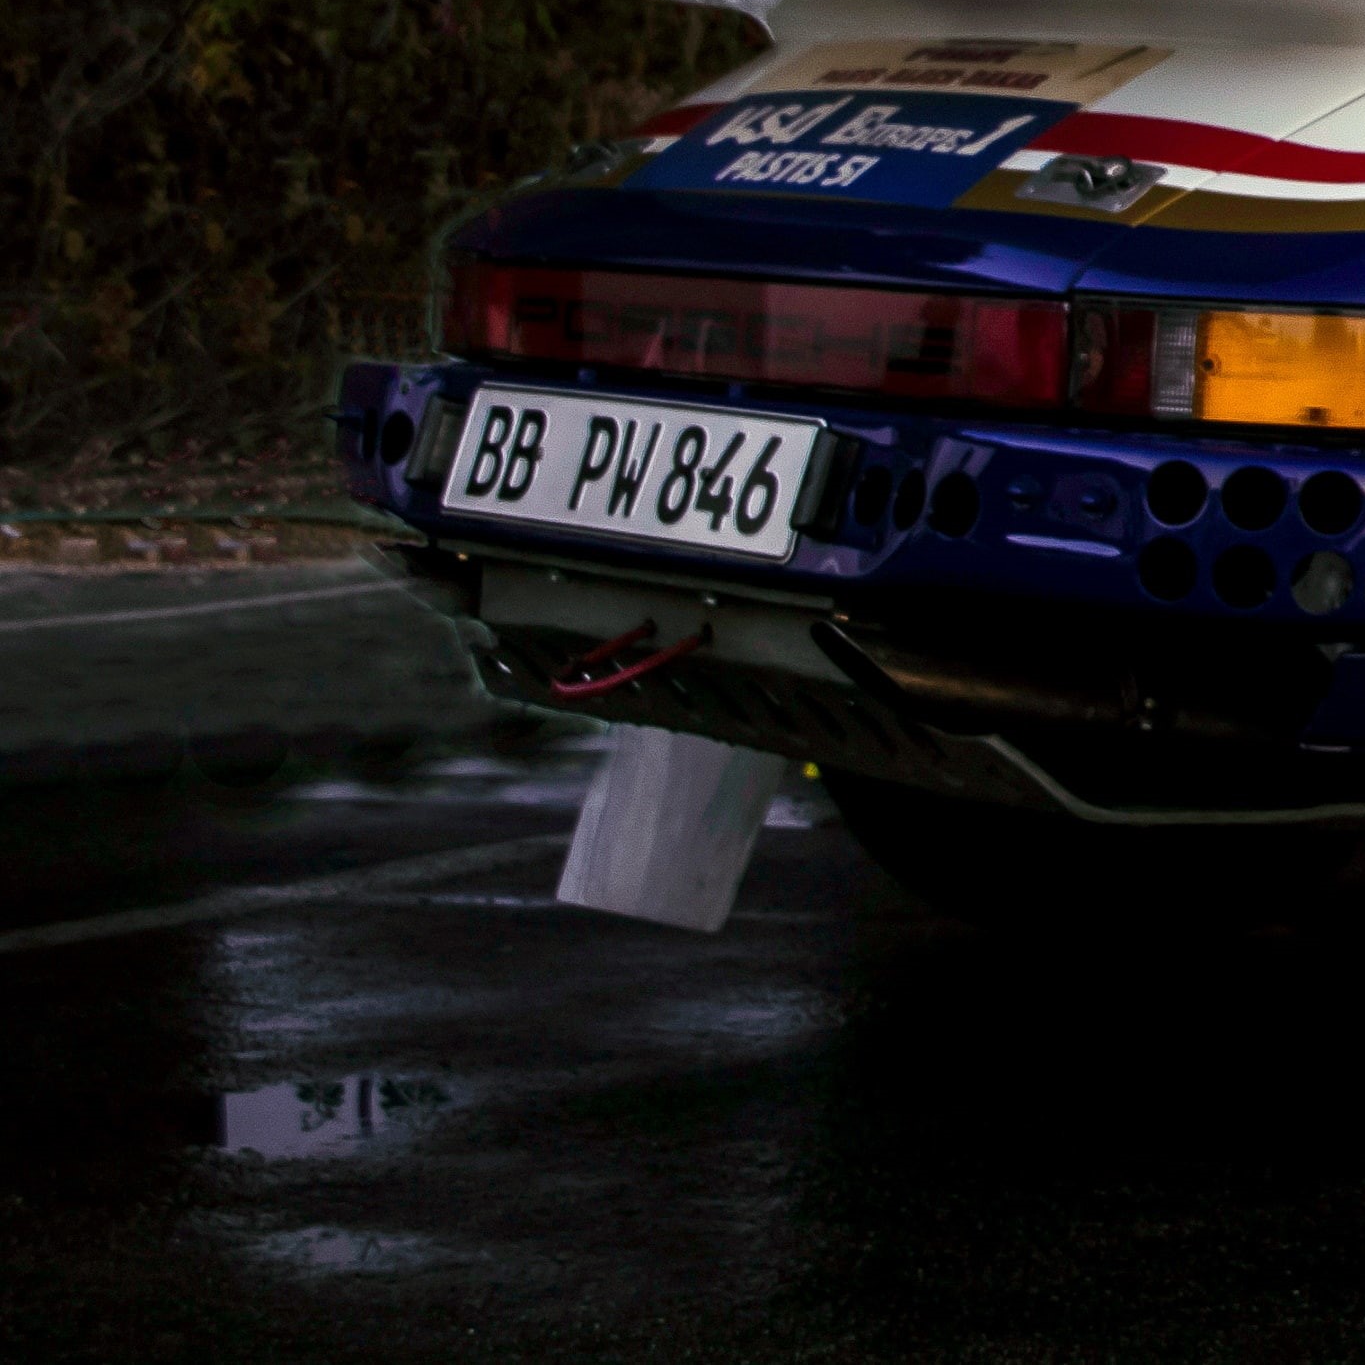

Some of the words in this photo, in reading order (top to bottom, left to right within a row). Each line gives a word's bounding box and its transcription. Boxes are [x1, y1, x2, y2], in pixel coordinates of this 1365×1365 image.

[713, 151, 842, 185] PASTIS
[465, 405, 549, 502] BB
[567, 415, 660, 518] PW
[655, 424, 783, 536] 846
